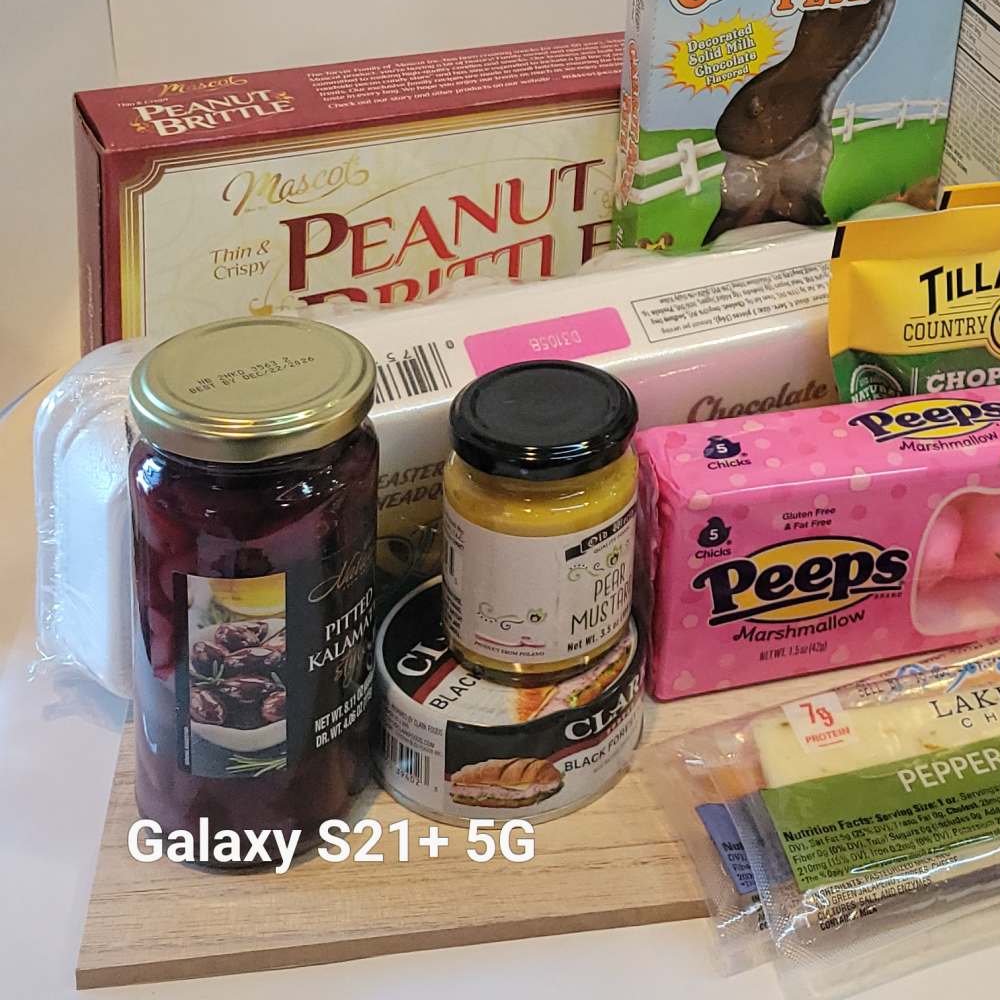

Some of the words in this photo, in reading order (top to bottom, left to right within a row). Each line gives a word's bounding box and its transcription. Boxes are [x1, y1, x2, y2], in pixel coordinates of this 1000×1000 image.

[687, 23, 754, 54] Decorated
[689, 46, 723, 68] Solid
[725, 37, 756, 54] Milk
[694, 50, 758, 80] Chocolate
[704, 64, 750, 88] Flavored
[133, 90, 271, 122] PEANUT
[151, 101, 295, 137] BRITTLE
[222, 154, 369, 217] Mascot
[279, 158, 604, 292] PEANUT
[210, 245, 254, 265] Thin
[256, 239, 271, 255] &
[213, 261, 269, 281] Crispy
[904, 315, 988, 342] COUNTRY
[687, 380, 828, 422] Chocolate
[716, 443, 728, 453] 5
[900, 431, 998, 452] Marshmallow
[707, 458, 751, 470] Chicks
[782, 510, 812, 521] Gluten
[816, 507, 836, 516] Free
[785, 523, 791, 531] &
[794, 521, 809, 530] Fat
[811, 518, 831, 528] Free
[710, 529, 719, 540] 5
[695, 547, 731, 559] Chicks
[594, 562, 626, 602] PEAR
[693, 550, 909, 614] Peeps
[326, 587, 373, 642] PITTED
[733, 610, 865, 642] Marshmallow
[567, 641, 583, 653] Net
[585, 635, 598, 645] Wt.
[600, 625, 612, 639] 3.5
[501, 649, 518, 657] FROM
[314, 713, 331, 733] NET
[331, 706, 343, 724] WT.
[800, 702, 835, 728] 7g
[315, 731, 330, 749] DR.
[331, 722, 343, 740] WT.
[805, 726, 850, 744] PROTEIN
[564, 747, 606, 772] BLACK
[780, 820, 838, 844] Nutrition
[836, 811, 875, 831] Facts:
[872, 804, 914, 824] Serving
